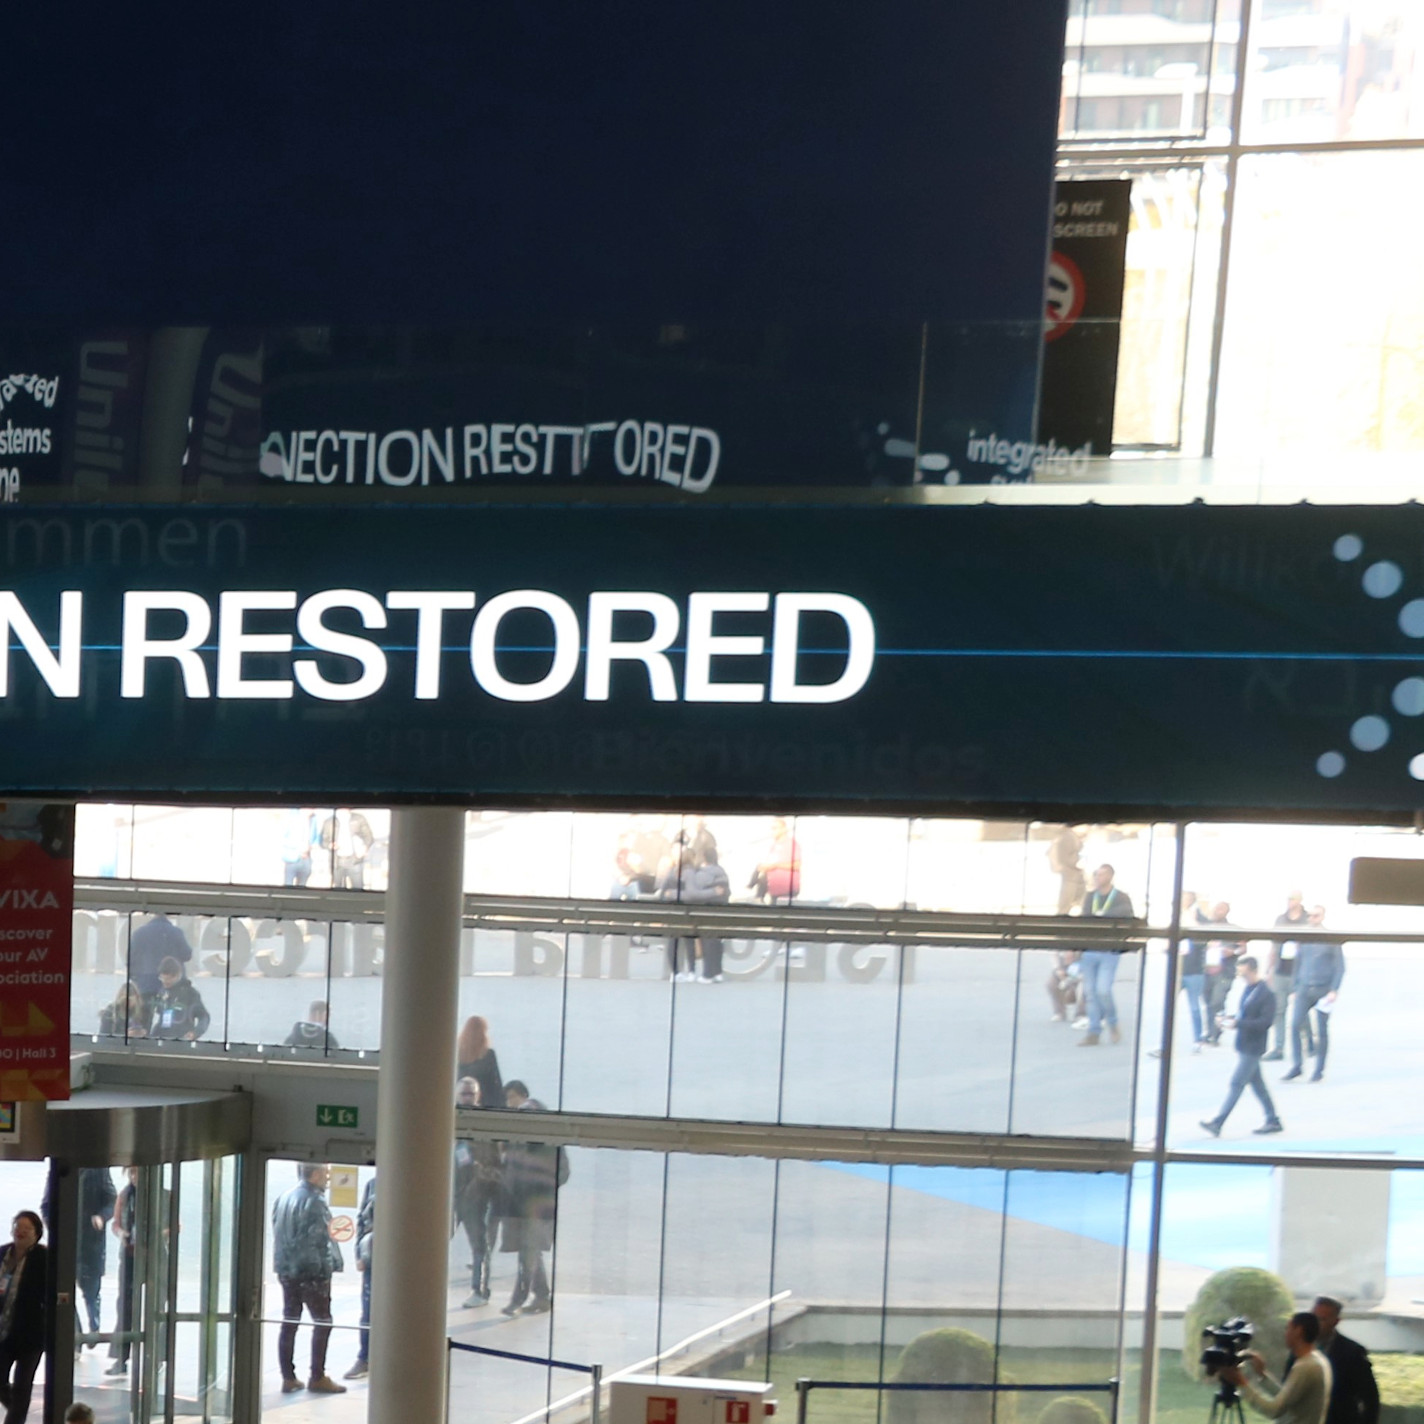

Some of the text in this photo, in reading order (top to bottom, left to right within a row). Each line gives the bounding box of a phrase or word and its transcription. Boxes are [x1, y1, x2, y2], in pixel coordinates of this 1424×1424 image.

[1054, 200, 1105, 217] O NOT
[1053, 221, 1120, 238] SCREEN
[966, 428, 1093, 477] integrated
[122, 590, 875, 702] RESTORED
[25, 948, 49, 963] AV
[22, 1047, 47, 1060] Hall
[49, 1047, 57, 1059] 3
